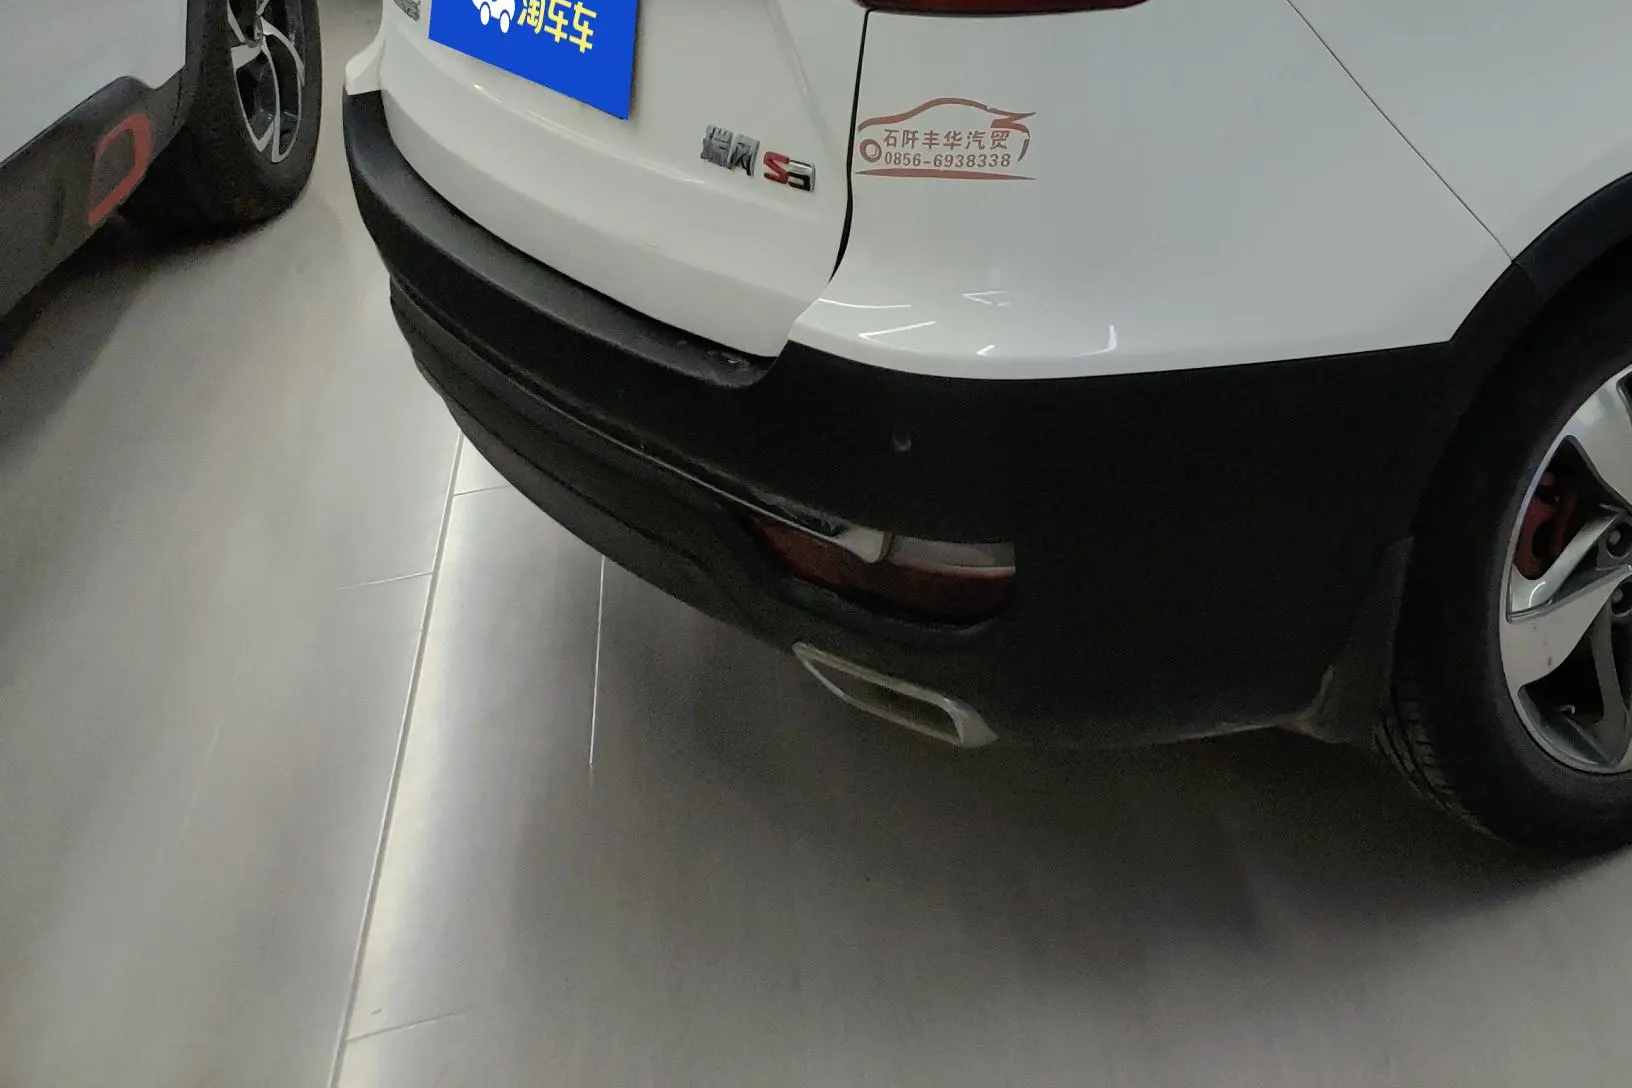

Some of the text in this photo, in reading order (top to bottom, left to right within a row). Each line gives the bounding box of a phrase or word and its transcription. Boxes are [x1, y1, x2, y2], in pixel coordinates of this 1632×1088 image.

[883, 129, 1010, 150] 石阡丰华汽贸
[884, 151, 1012, 168] 0856-6938338
